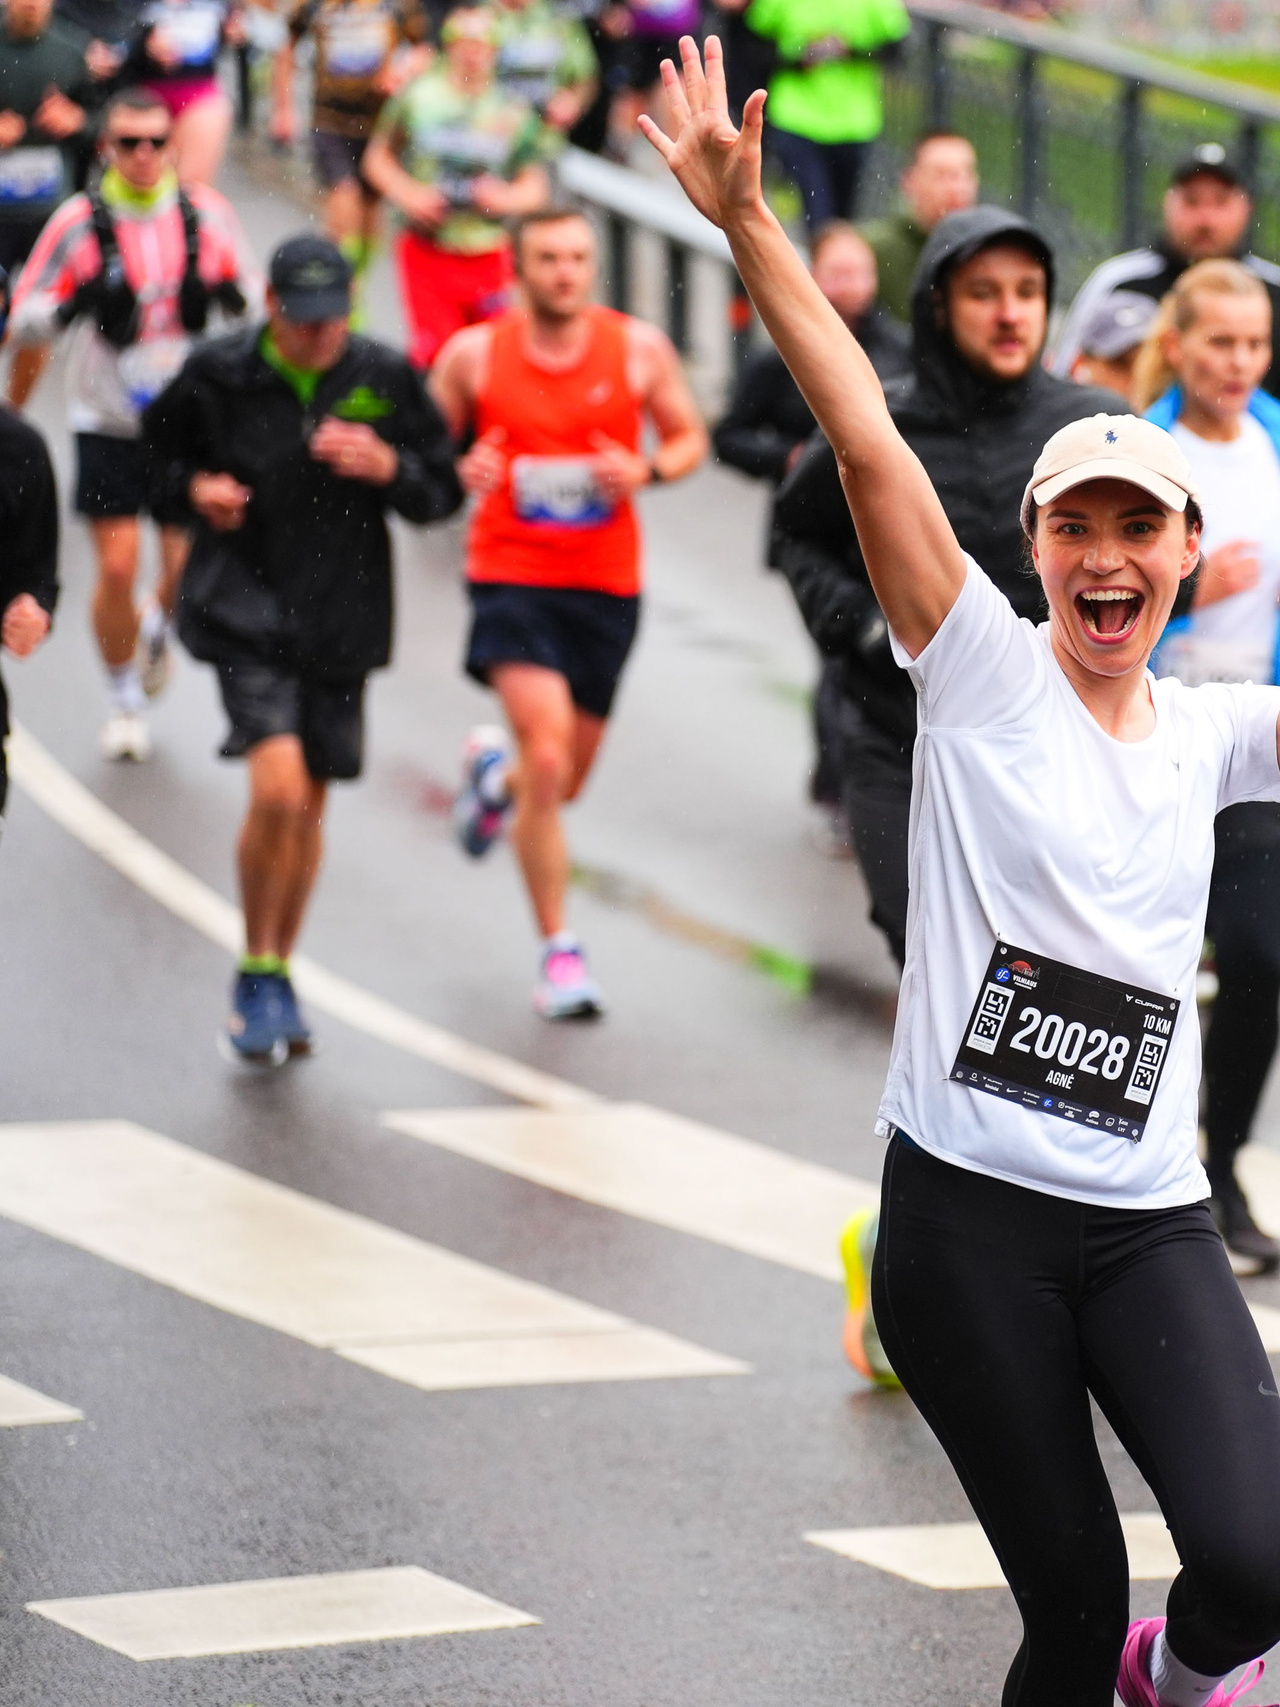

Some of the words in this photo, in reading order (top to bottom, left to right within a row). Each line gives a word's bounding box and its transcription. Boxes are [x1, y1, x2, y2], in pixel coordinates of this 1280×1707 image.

[1012, 974, 1038, 988] VILNIAUS
[1134, 998, 1164, 1012] CUPRA
[1143, 1013, 1156, 1030] 10
[1155, 1017, 1172, 1035] KM
[1009, 1006, 1131, 1081] 20028
